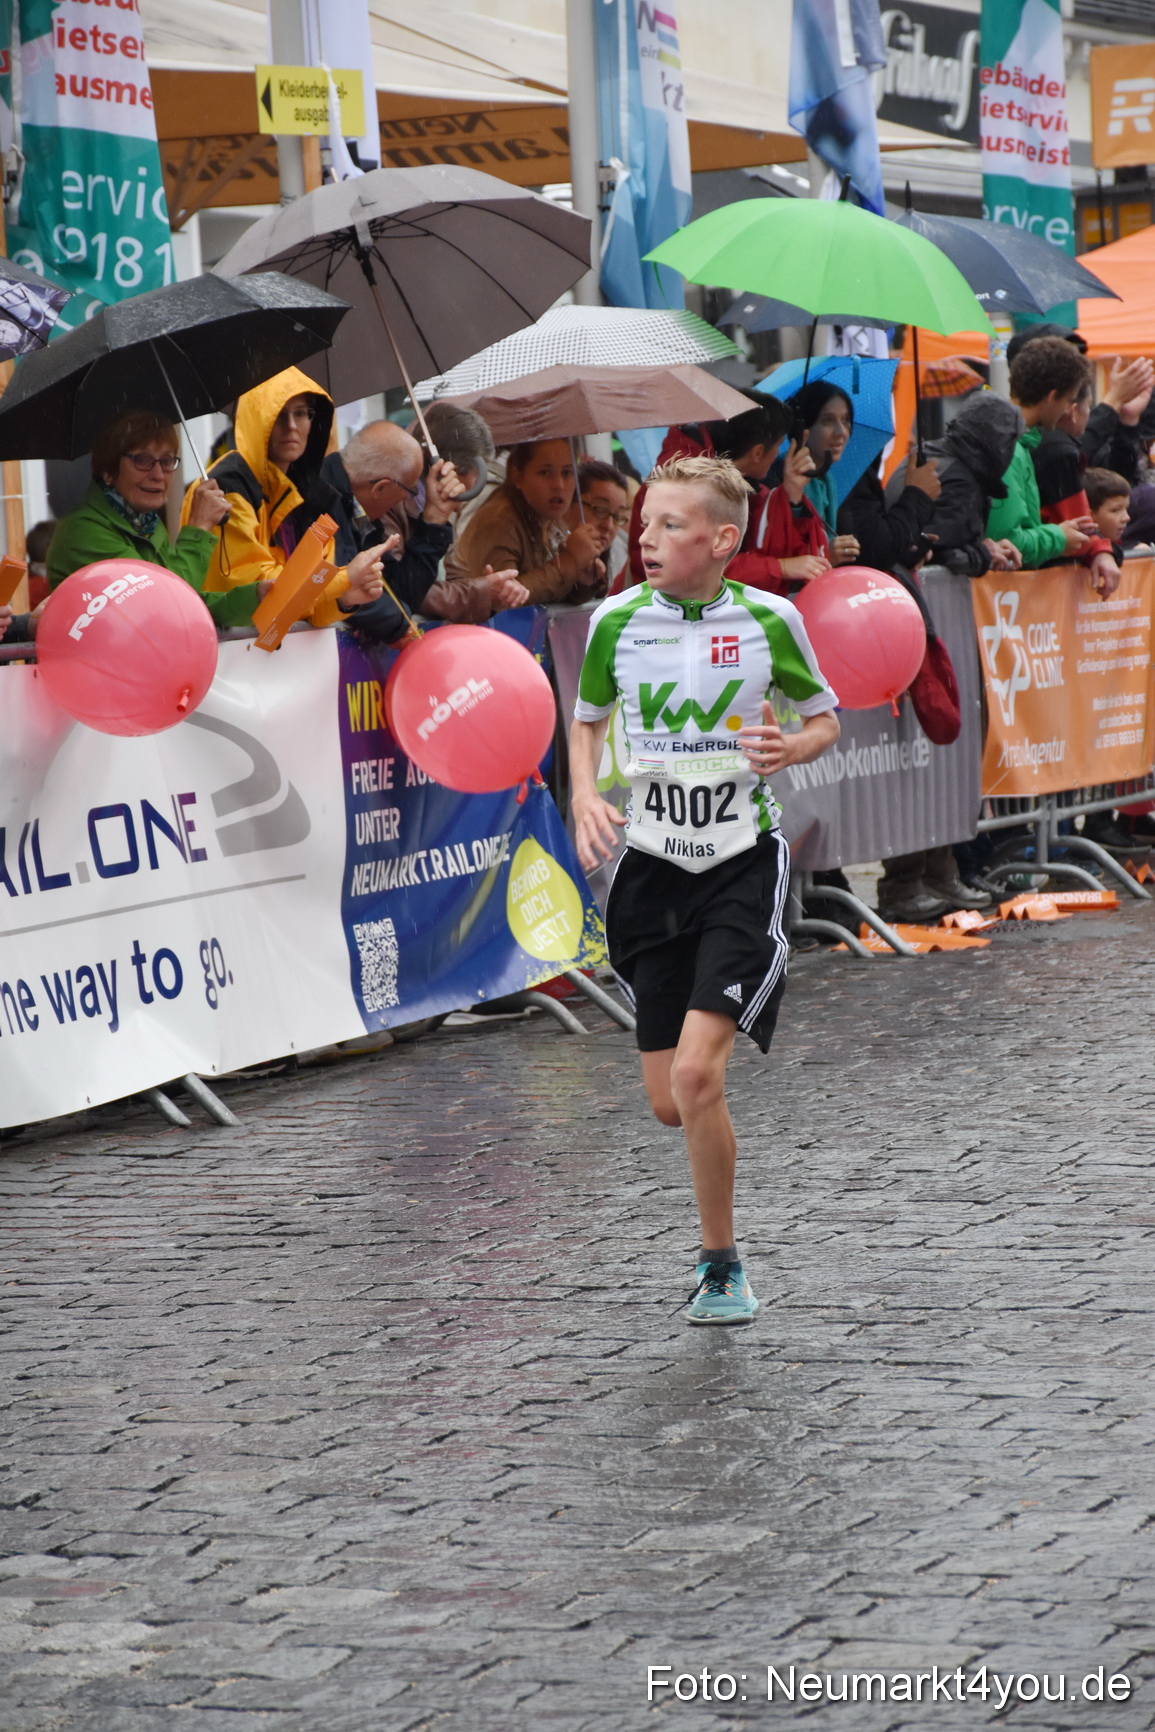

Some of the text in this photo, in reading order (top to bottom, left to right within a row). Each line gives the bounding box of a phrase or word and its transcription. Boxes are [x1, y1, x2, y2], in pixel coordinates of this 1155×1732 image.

[294, 105, 329, 127] ausgab
[68, 573, 149, 641] RÖDL
[633, 637, 680, 648] smartblock
[1028, 621, 1061, 655] CODE
[346, 680, 387, 733] WIR
[416, 677, 490, 742] RÖDL
[643, 740, 743, 753] KW ENERGIE
[351, 757, 396, 795] FREIE
[674, 756, 740, 775] BOCK
[645, 781, 739, 829] 4002
[355, 806, 401, 847] UNTER
[664, 836, 716, 858] Niklas
[519, 889, 554, 926] DICH
[40, 959, 121, 1034] way
[131, 939, 184, 1006] to
